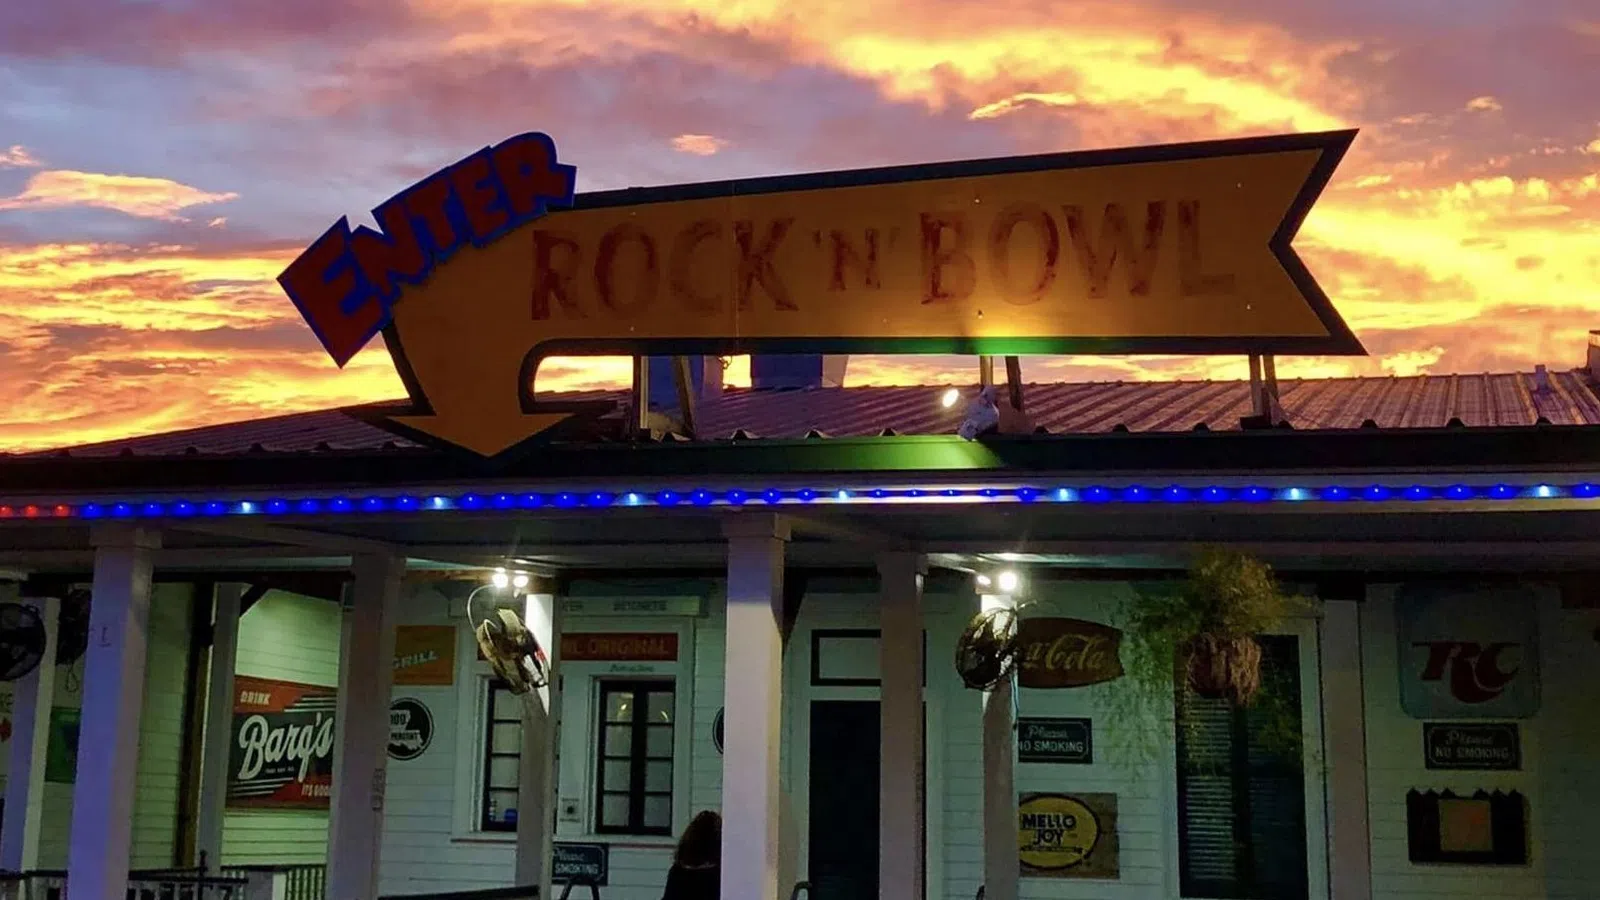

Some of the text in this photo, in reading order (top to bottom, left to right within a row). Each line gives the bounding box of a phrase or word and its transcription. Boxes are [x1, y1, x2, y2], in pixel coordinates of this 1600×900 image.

[279, 133, 575, 366] ENTER
[530, 216, 799, 321] ROCK
[920, 199, 1237, 305] BOWL
[1412, 640, 1520, 703] RC
[240, 691, 272, 706] DRINK
[237, 711, 334, 783] Barq's
[1034, 740, 1084, 753] SMOKING
[1435, 746, 1509, 760] NO SMOKING
[1021, 813, 1076, 829] MELLO
[1032, 829, 1064, 846] JOY
[554, 863, 599, 876] SMOKING
